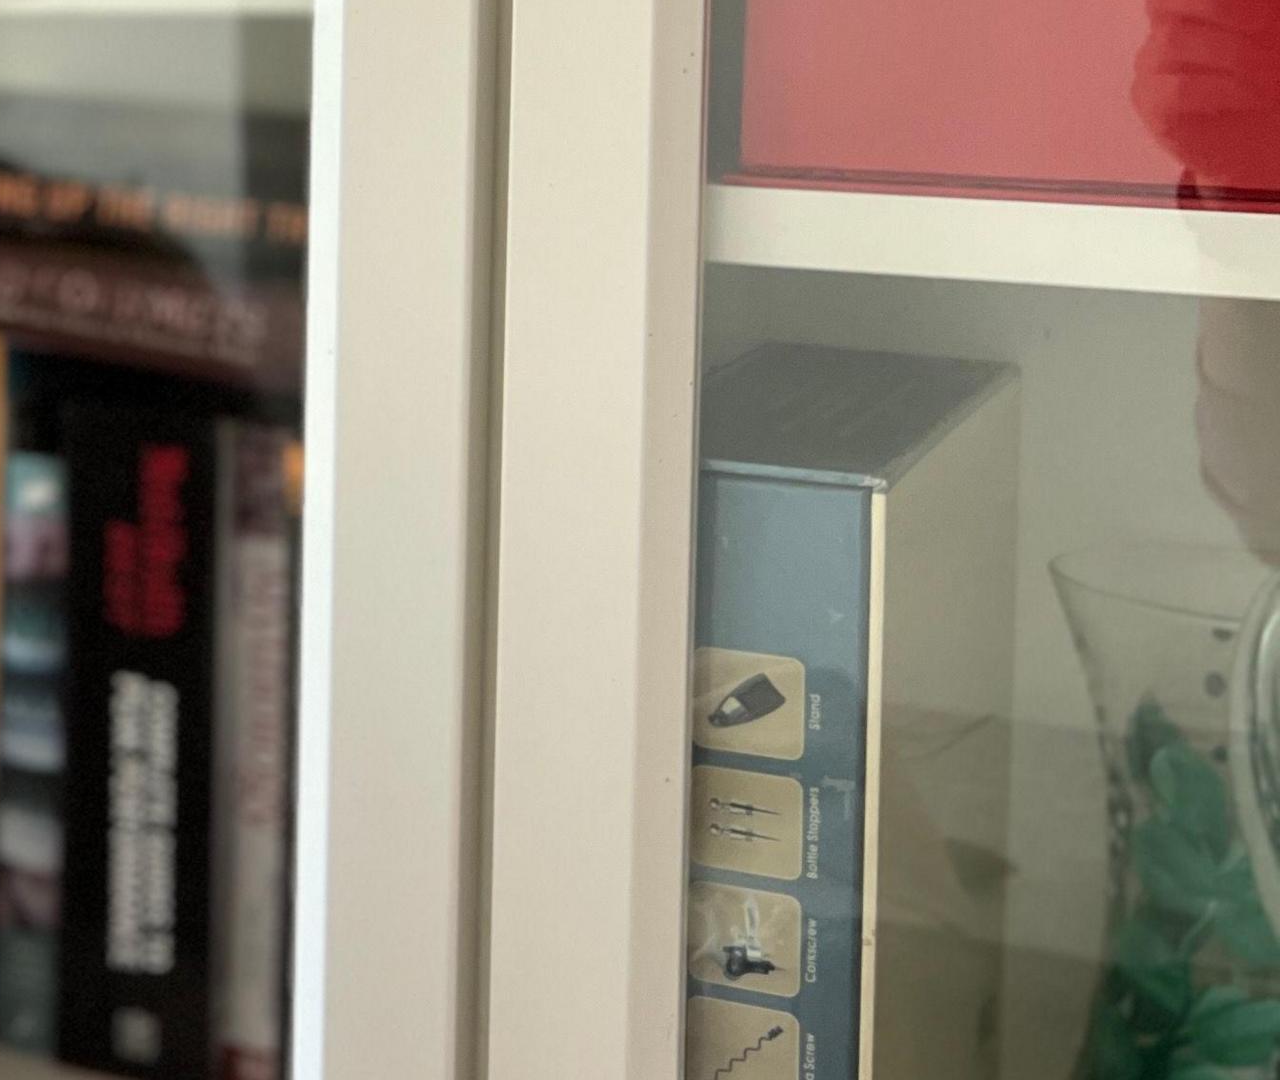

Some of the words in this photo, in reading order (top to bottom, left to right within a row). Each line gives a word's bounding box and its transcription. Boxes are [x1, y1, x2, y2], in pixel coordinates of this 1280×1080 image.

[809, 693, 821, 730] Stand
[806, 787, 821, 841] Stoppers
[806, 843, 819, 879] Bottle
[805, 918, 817, 983] Corkscrew
[804, 1033, 816, 1070] Screw
